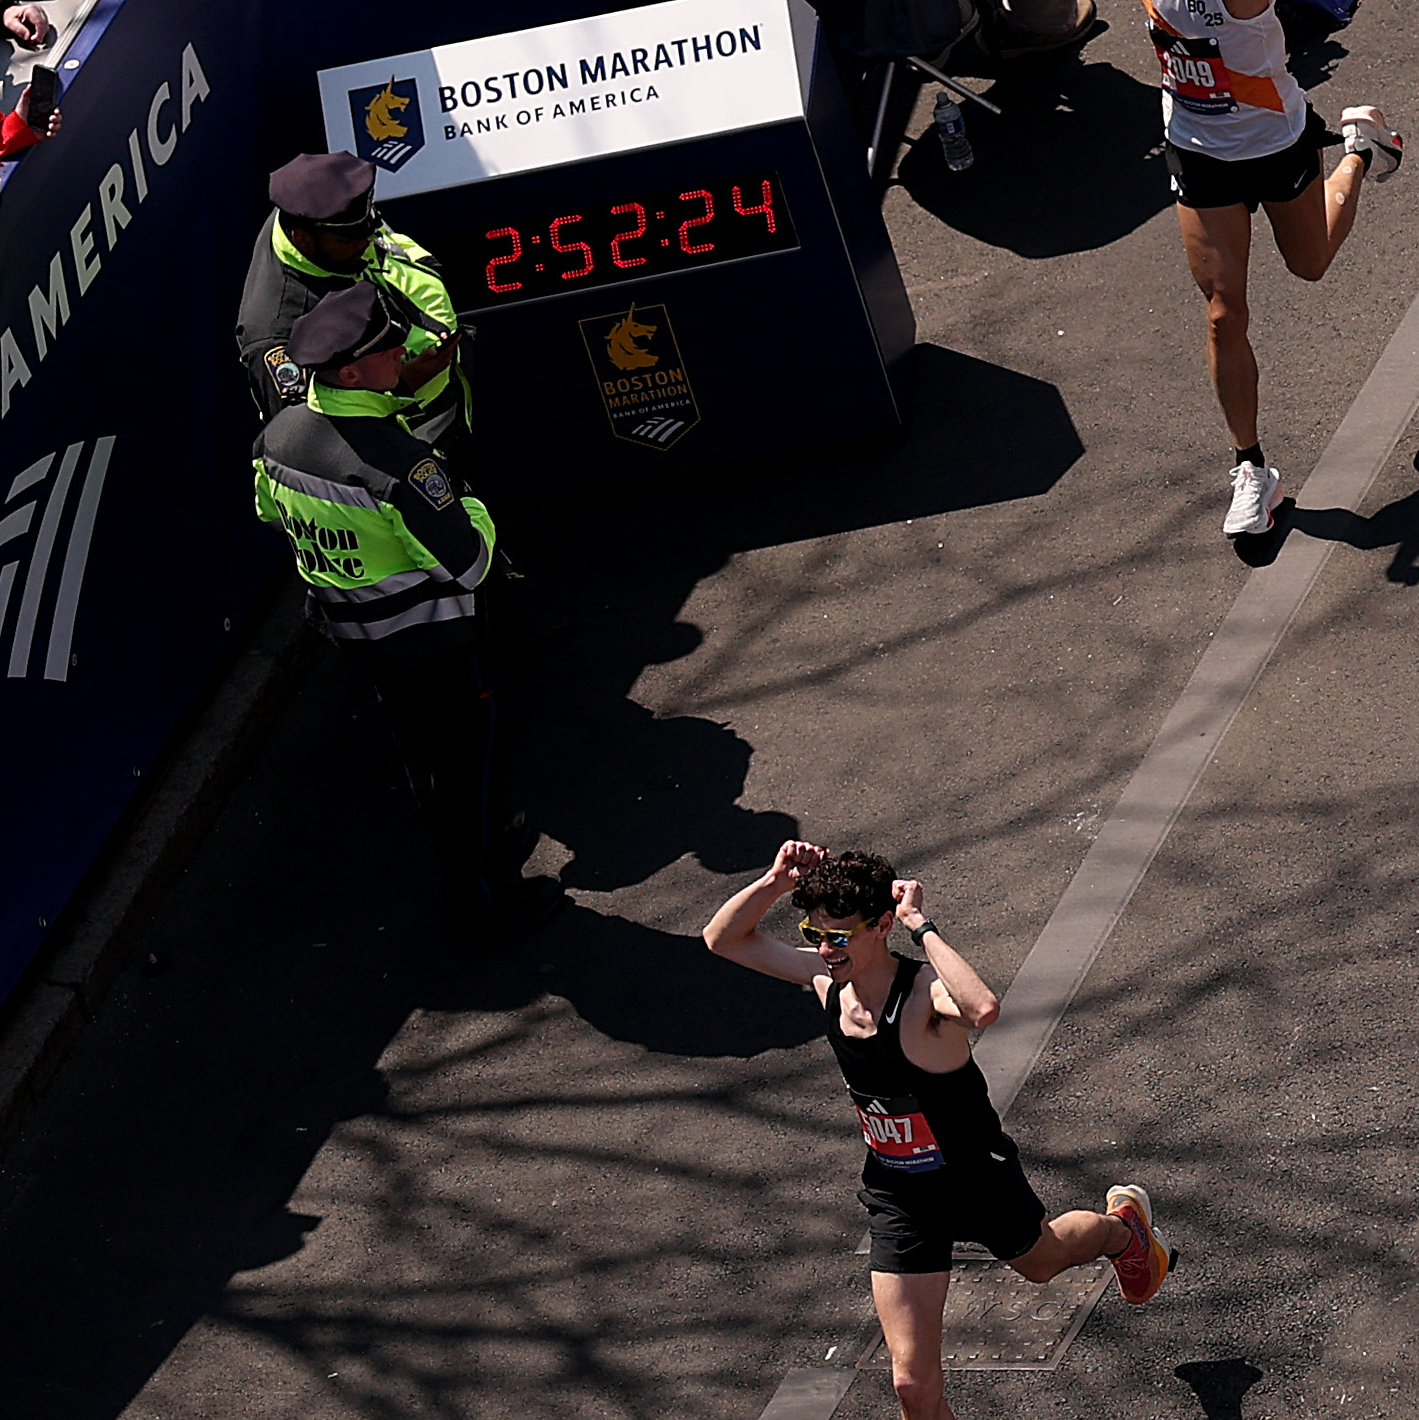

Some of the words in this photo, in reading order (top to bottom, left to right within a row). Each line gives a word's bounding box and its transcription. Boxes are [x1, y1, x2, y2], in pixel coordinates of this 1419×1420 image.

[1204, 12, 1224, 27] 25
[438, 63, 569, 114] BOSTON
[579, 24, 763, 85] MARATHON
[444, 113, 509, 141] BANK
[515, 106, 545, 126] OF
[552, 84, 661, 120] AMERICA
[1, 42, 211, 418] AMERICA
[485, 180, 777, 293] 2:52:24
[602, 367, 684, 397] BOSTON
[608, 383, 688, 409] MARATHON
[612, 408, 637, 420] BANK
[651, 398, 692, 412] AMERICA
[287, 531, 365, 578] olice
